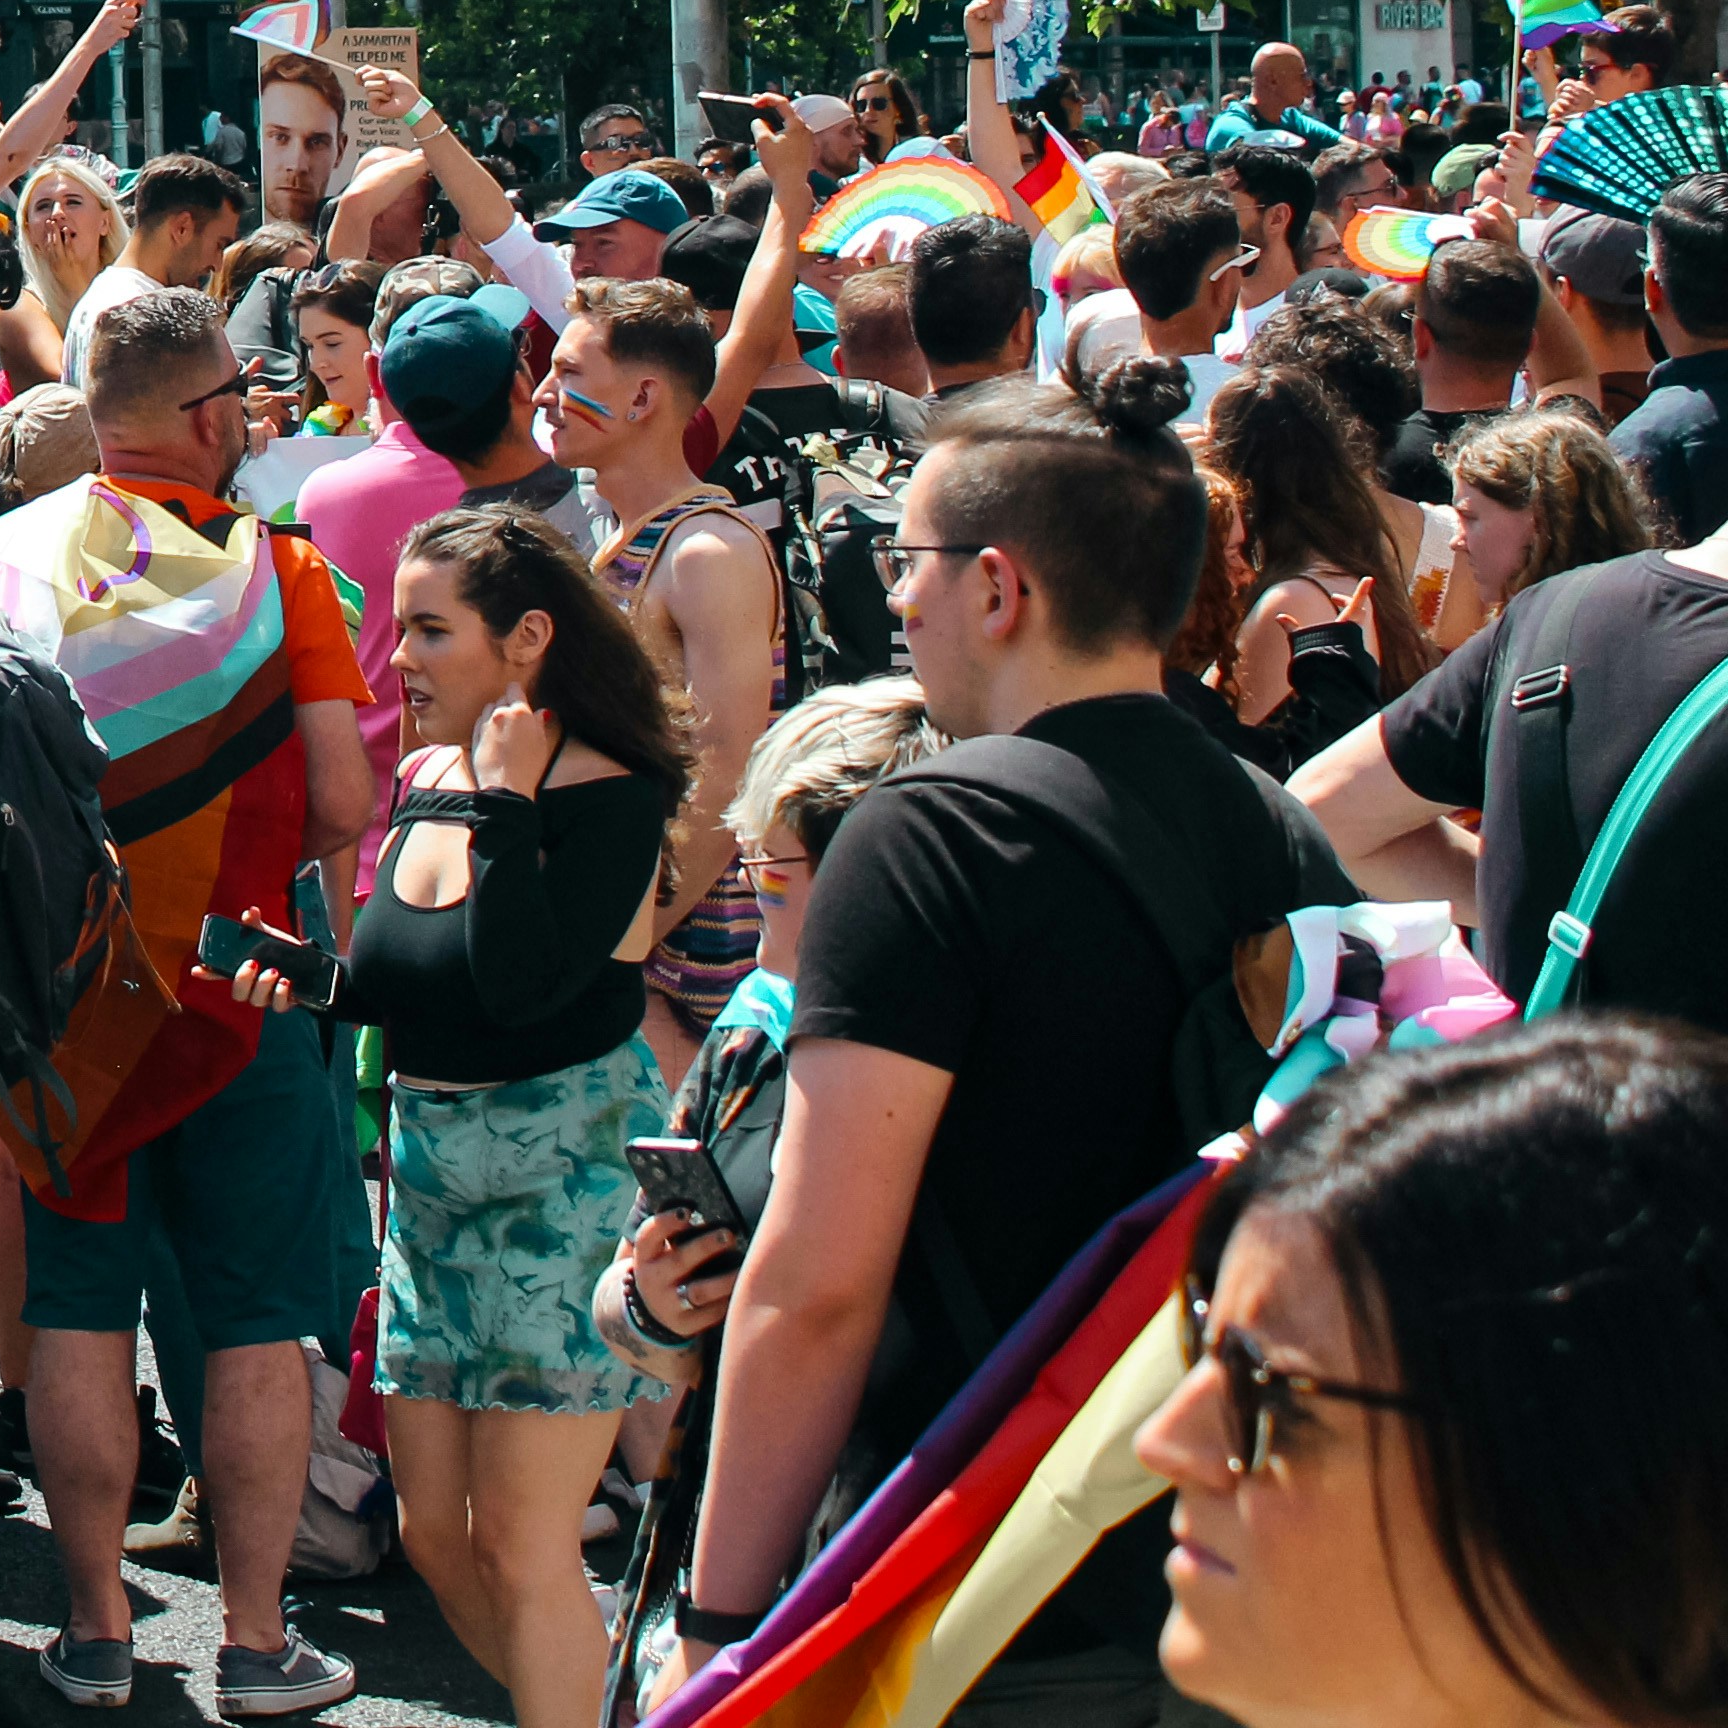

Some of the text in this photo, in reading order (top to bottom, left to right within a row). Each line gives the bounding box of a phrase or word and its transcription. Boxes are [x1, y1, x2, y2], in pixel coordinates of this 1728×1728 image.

[37, 6, 72, 14] GUINNESS
[343, 35, 412, 47] A SAMARITAN
[347, 51, 407, 63] HELPED ME
